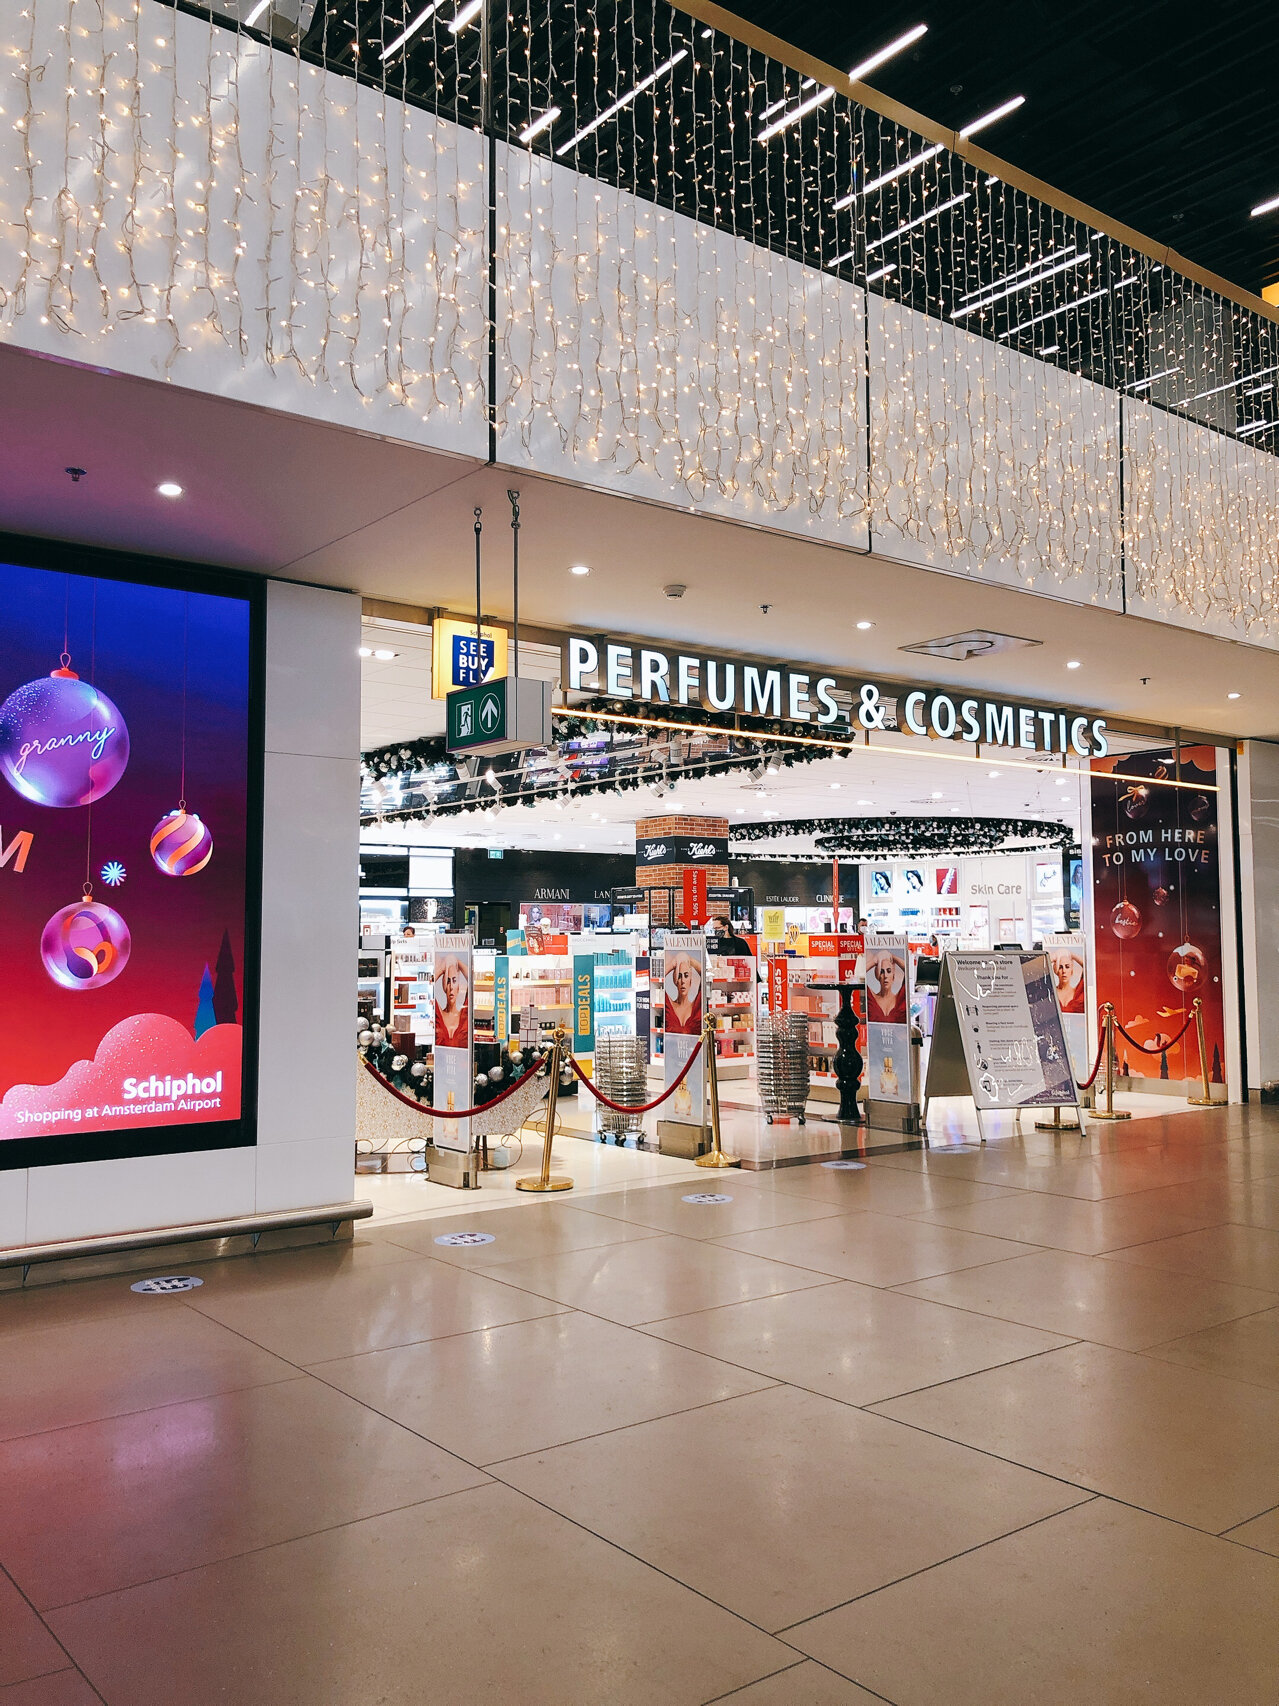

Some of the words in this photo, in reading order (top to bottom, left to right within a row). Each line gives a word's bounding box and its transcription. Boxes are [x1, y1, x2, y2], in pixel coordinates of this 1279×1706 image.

[470, 629, 493, 639] Scphol
[460, 640, 488, 656] SEE
[459, 654, 489, 671] BUY
[569, 637, 839, 724] PERFUMES
[858, 683, 887, 730] &
[905, 691, 1108, 758] COSMETICS
[14, 726, 116, 775] granny
[1106, 830, 1153, 848] FROM
[1161, 829, 1206, 844] HERE
[1102, 851, 1124, 867] TO
[1131, 848, 1157, 863] MY
[1165, 848, 1209, 864] LOVE
[534, 888, 570, 899] ARMANI
[691, 886, 698, 894] up
[971, 884, 993, 895] Skin
[997, 884, 1022, 895] Care
[692, 894, 699, 902] to
[816, 894, 844, 903] CLINUE
[664, 936, 702, 947] VALENTINO
[811, 940, 835, 948] SPECIAL
[840, 940, 863, 948] SPECIAL
[865, 936, 905, 947] VALENTINO
[1043, 936, 1084, 945] VALENTINO
[497, 977, 506, 1013] DEALS
[578, 974, 591, 1012] DEALS
[579, 1011, 589, 1033] TOP
[123, 1071, 223, 1101] Schiphol
[16, 1109, 82, 1124] Shopping
[85, 1107, 99, 1118] at
[101, 1101, 175, 1117] Amsterdam
[177, 1097, 222, 1112] Airport
